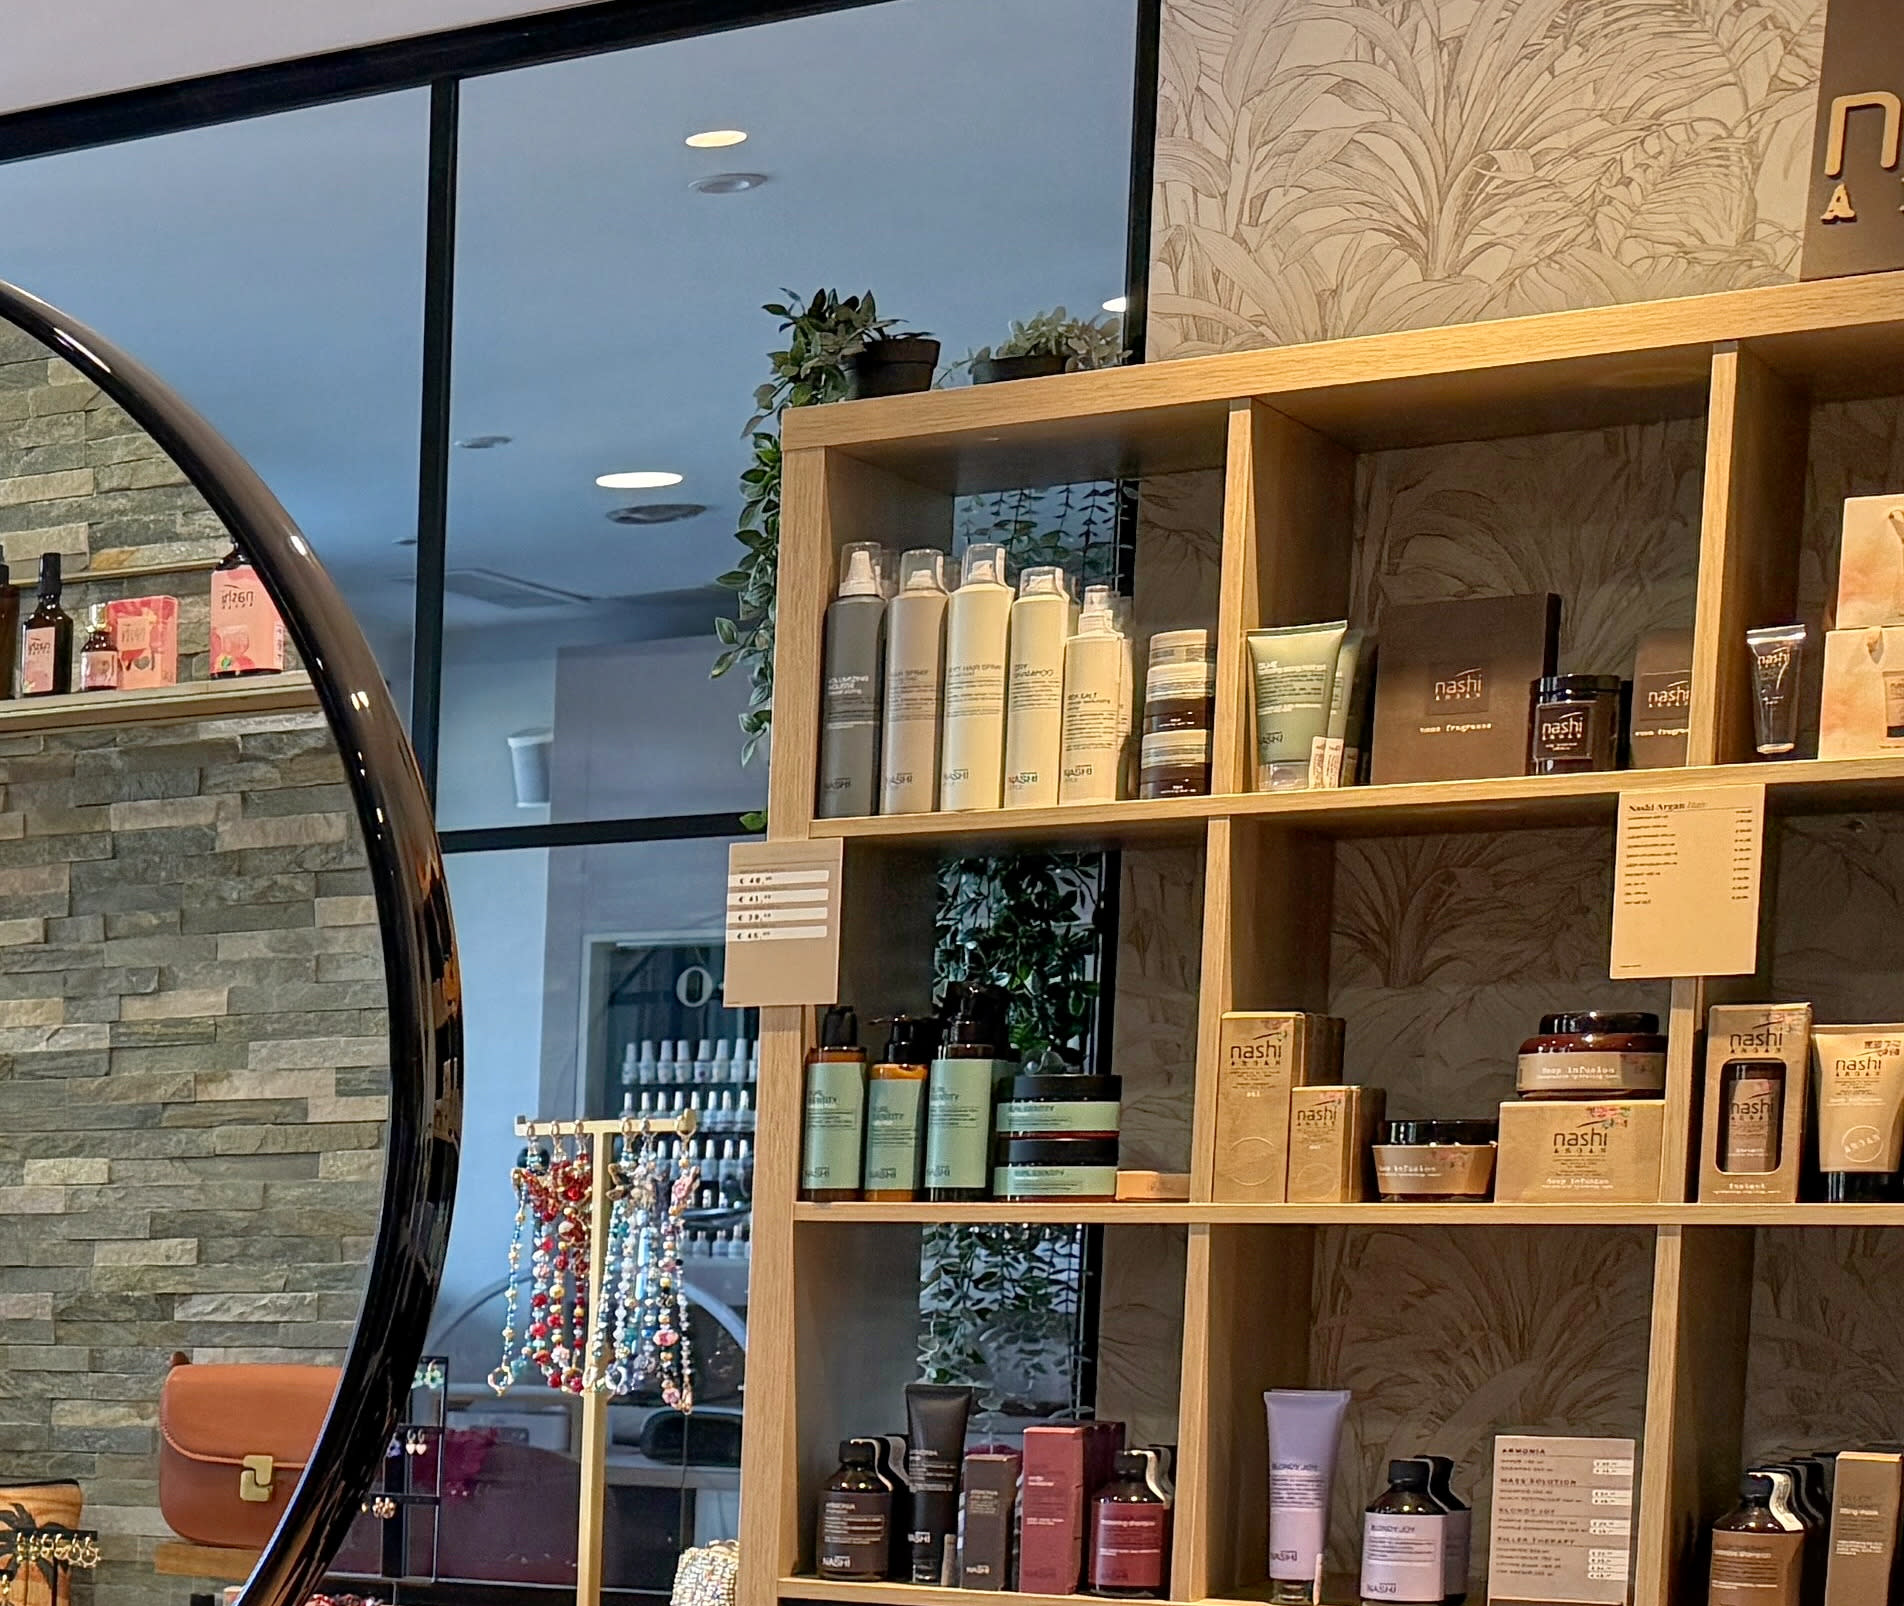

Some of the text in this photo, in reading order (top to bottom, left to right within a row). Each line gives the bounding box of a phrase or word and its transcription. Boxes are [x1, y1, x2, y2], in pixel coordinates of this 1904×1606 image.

[1435, 673, 1482, 694] nashi
[1542, 716, 1584, 735] nashi
[1730, 1027, 1784, 1048] nashi
[1230, 1039, 1282, 1059] nashi
[1835, 1056, 1882, 1072] nashi
[1297, 1105, 1338, 1121] nashi
[1731, 1099, 1775, 1115] nashi
[1553, 1126, 1608, 1147] nashi
